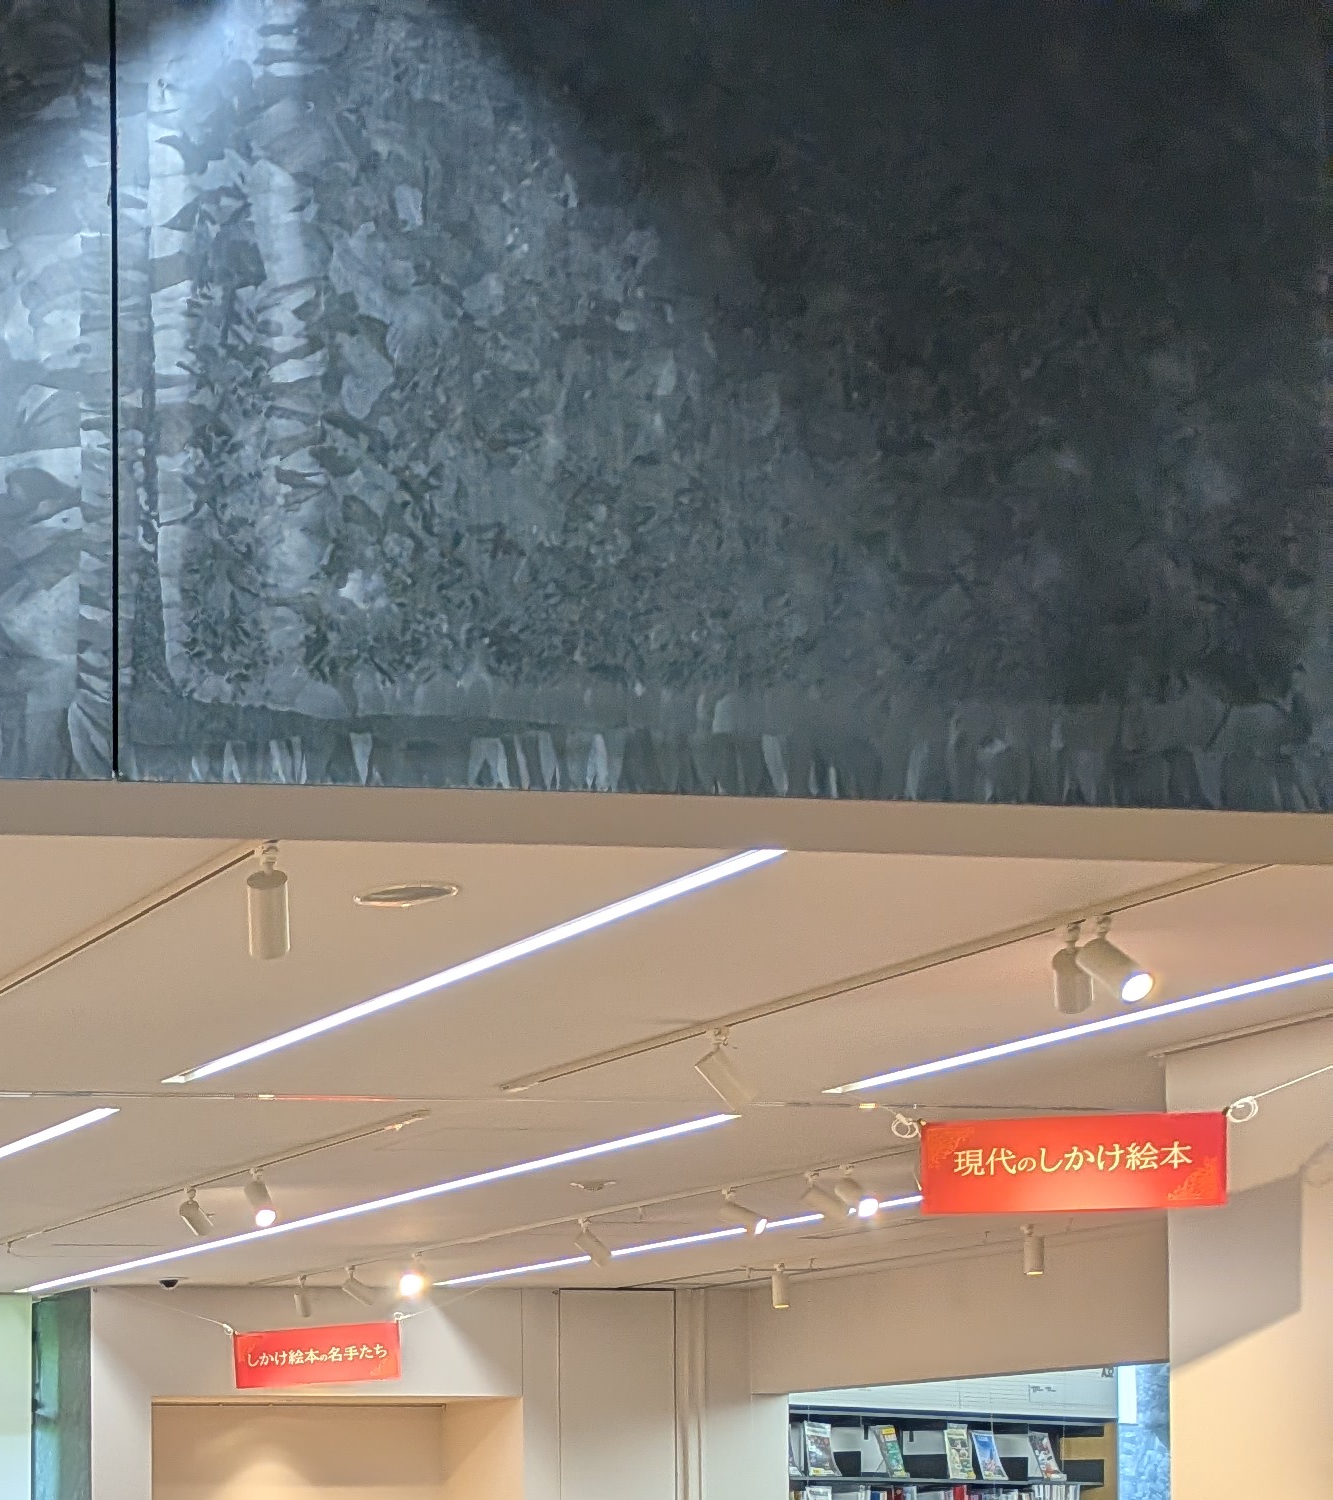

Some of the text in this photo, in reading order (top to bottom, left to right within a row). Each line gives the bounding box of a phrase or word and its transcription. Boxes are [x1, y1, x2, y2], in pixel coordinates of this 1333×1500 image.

[953, 1140, 1193, 1177] 現代のしかけ絵本
[247, 1342, 389, 1368] しかけ絵本の名手たち
